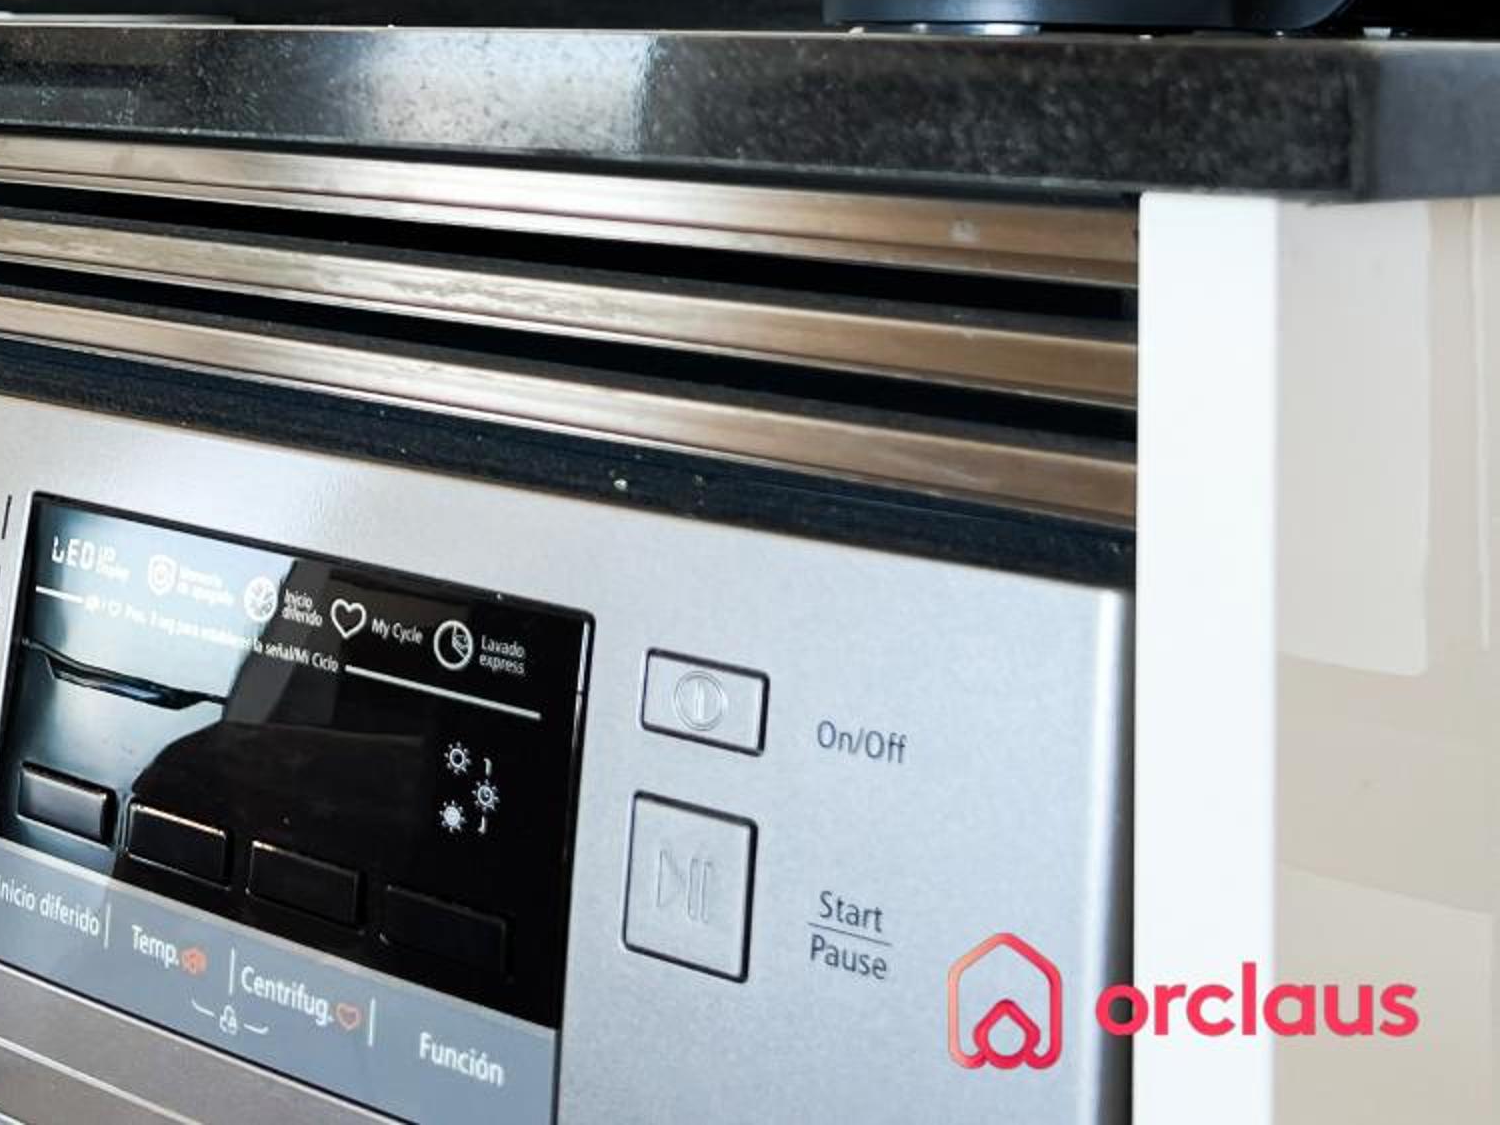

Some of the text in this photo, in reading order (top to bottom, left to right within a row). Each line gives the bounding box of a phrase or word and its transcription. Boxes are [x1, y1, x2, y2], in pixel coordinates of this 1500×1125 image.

[371, 618, 425, 646] My Cycle
[480, 634, 525, 658] Lavado
[311, 654, 340, 673] Ciclo
[478, 653, 526, 677] express
[816, 720, 908, 765] On/Off
[39, 892, 100, 937] diferido
[818, 890, 885, 935] Start
[131, 924, 180, 969] Temp.
[809, 934, 890, 981] Pause
[240, 966, 335, 1028] Centrifug.
[418, 1031, 505, 1087] Función
